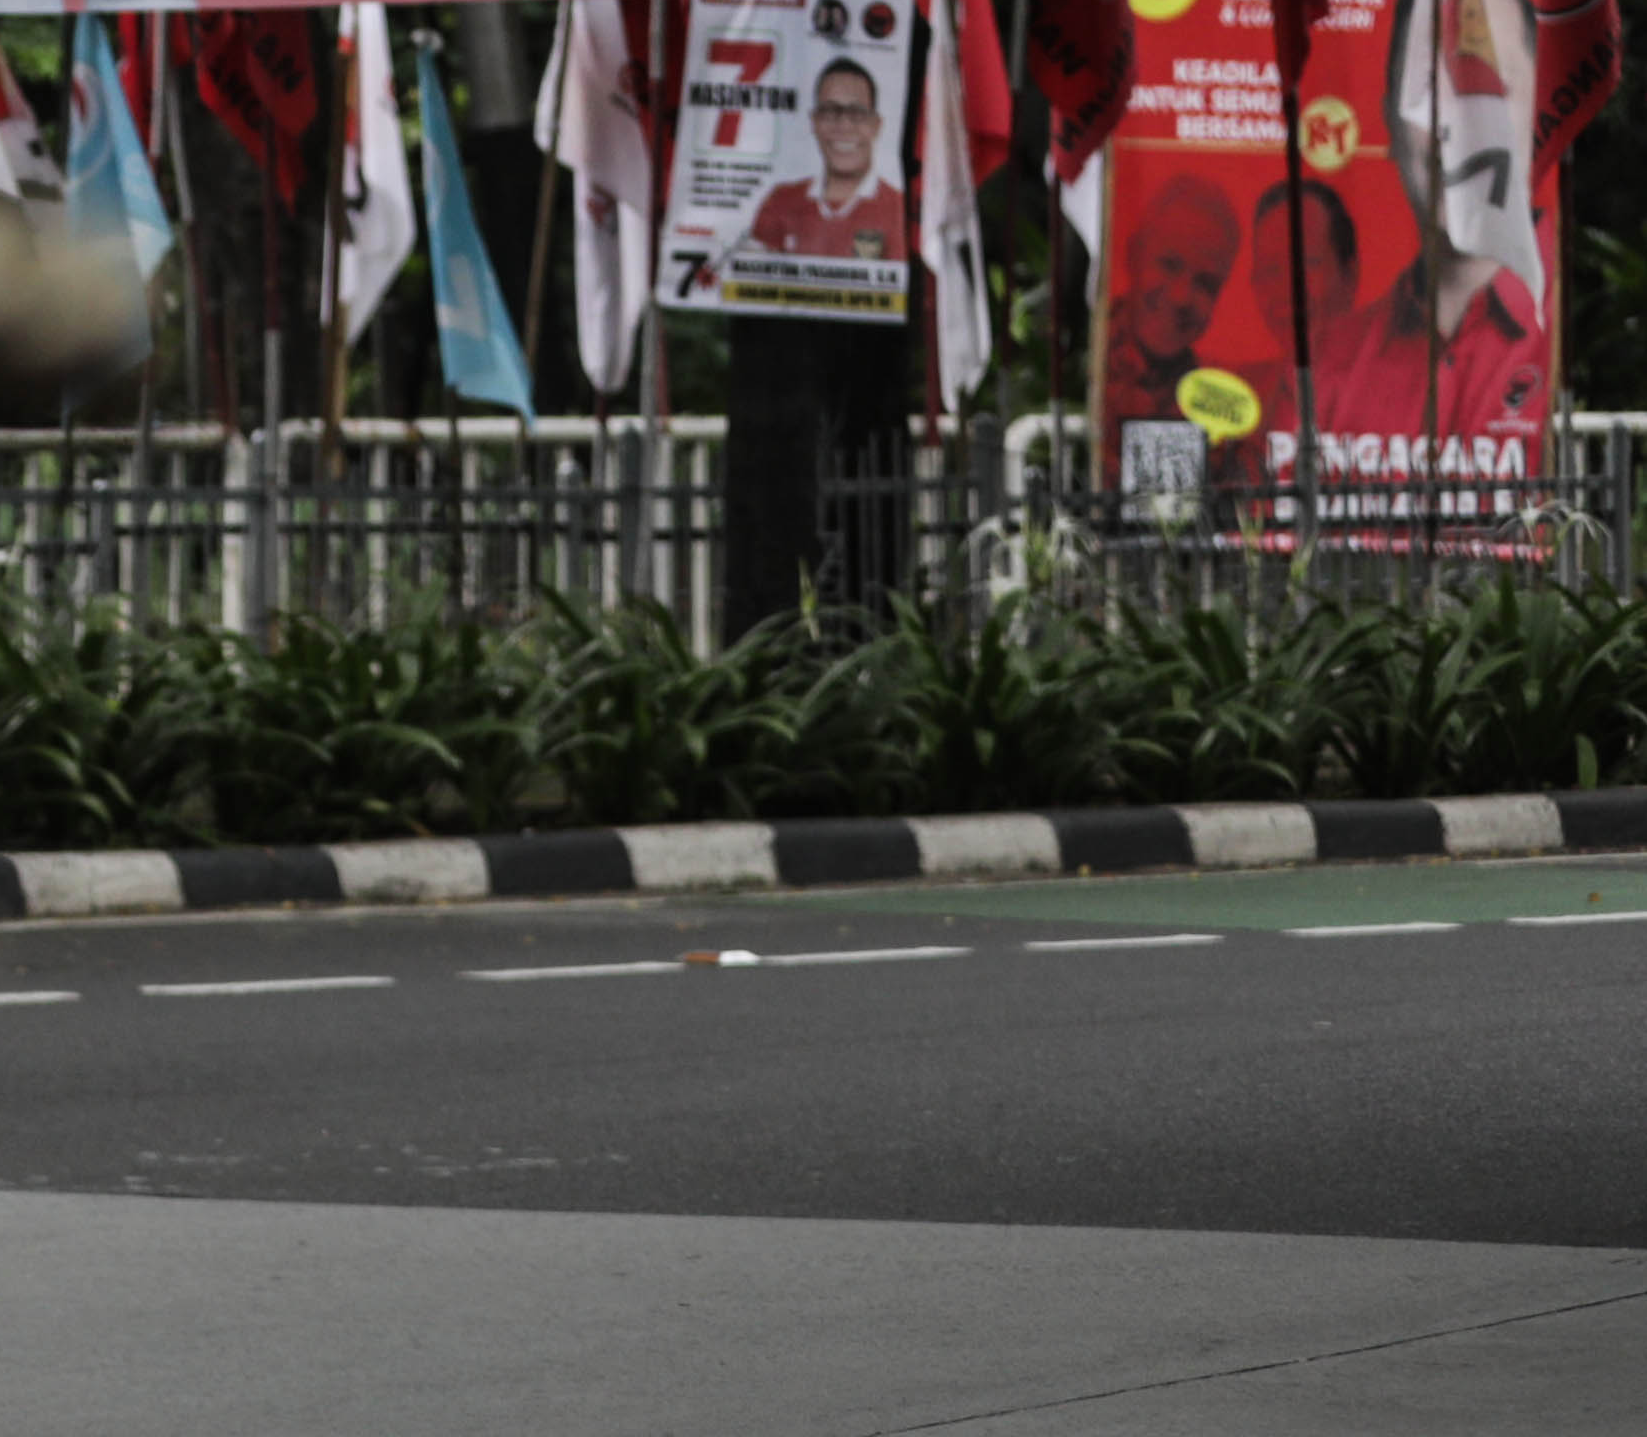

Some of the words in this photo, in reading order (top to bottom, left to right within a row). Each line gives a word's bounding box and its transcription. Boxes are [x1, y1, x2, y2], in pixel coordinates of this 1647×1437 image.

[1173, 58, 1282, 86] KEADILA
[688, 83, 798, 113] MASINTON
[1265, 430, 1526, 480] PNGACARA
